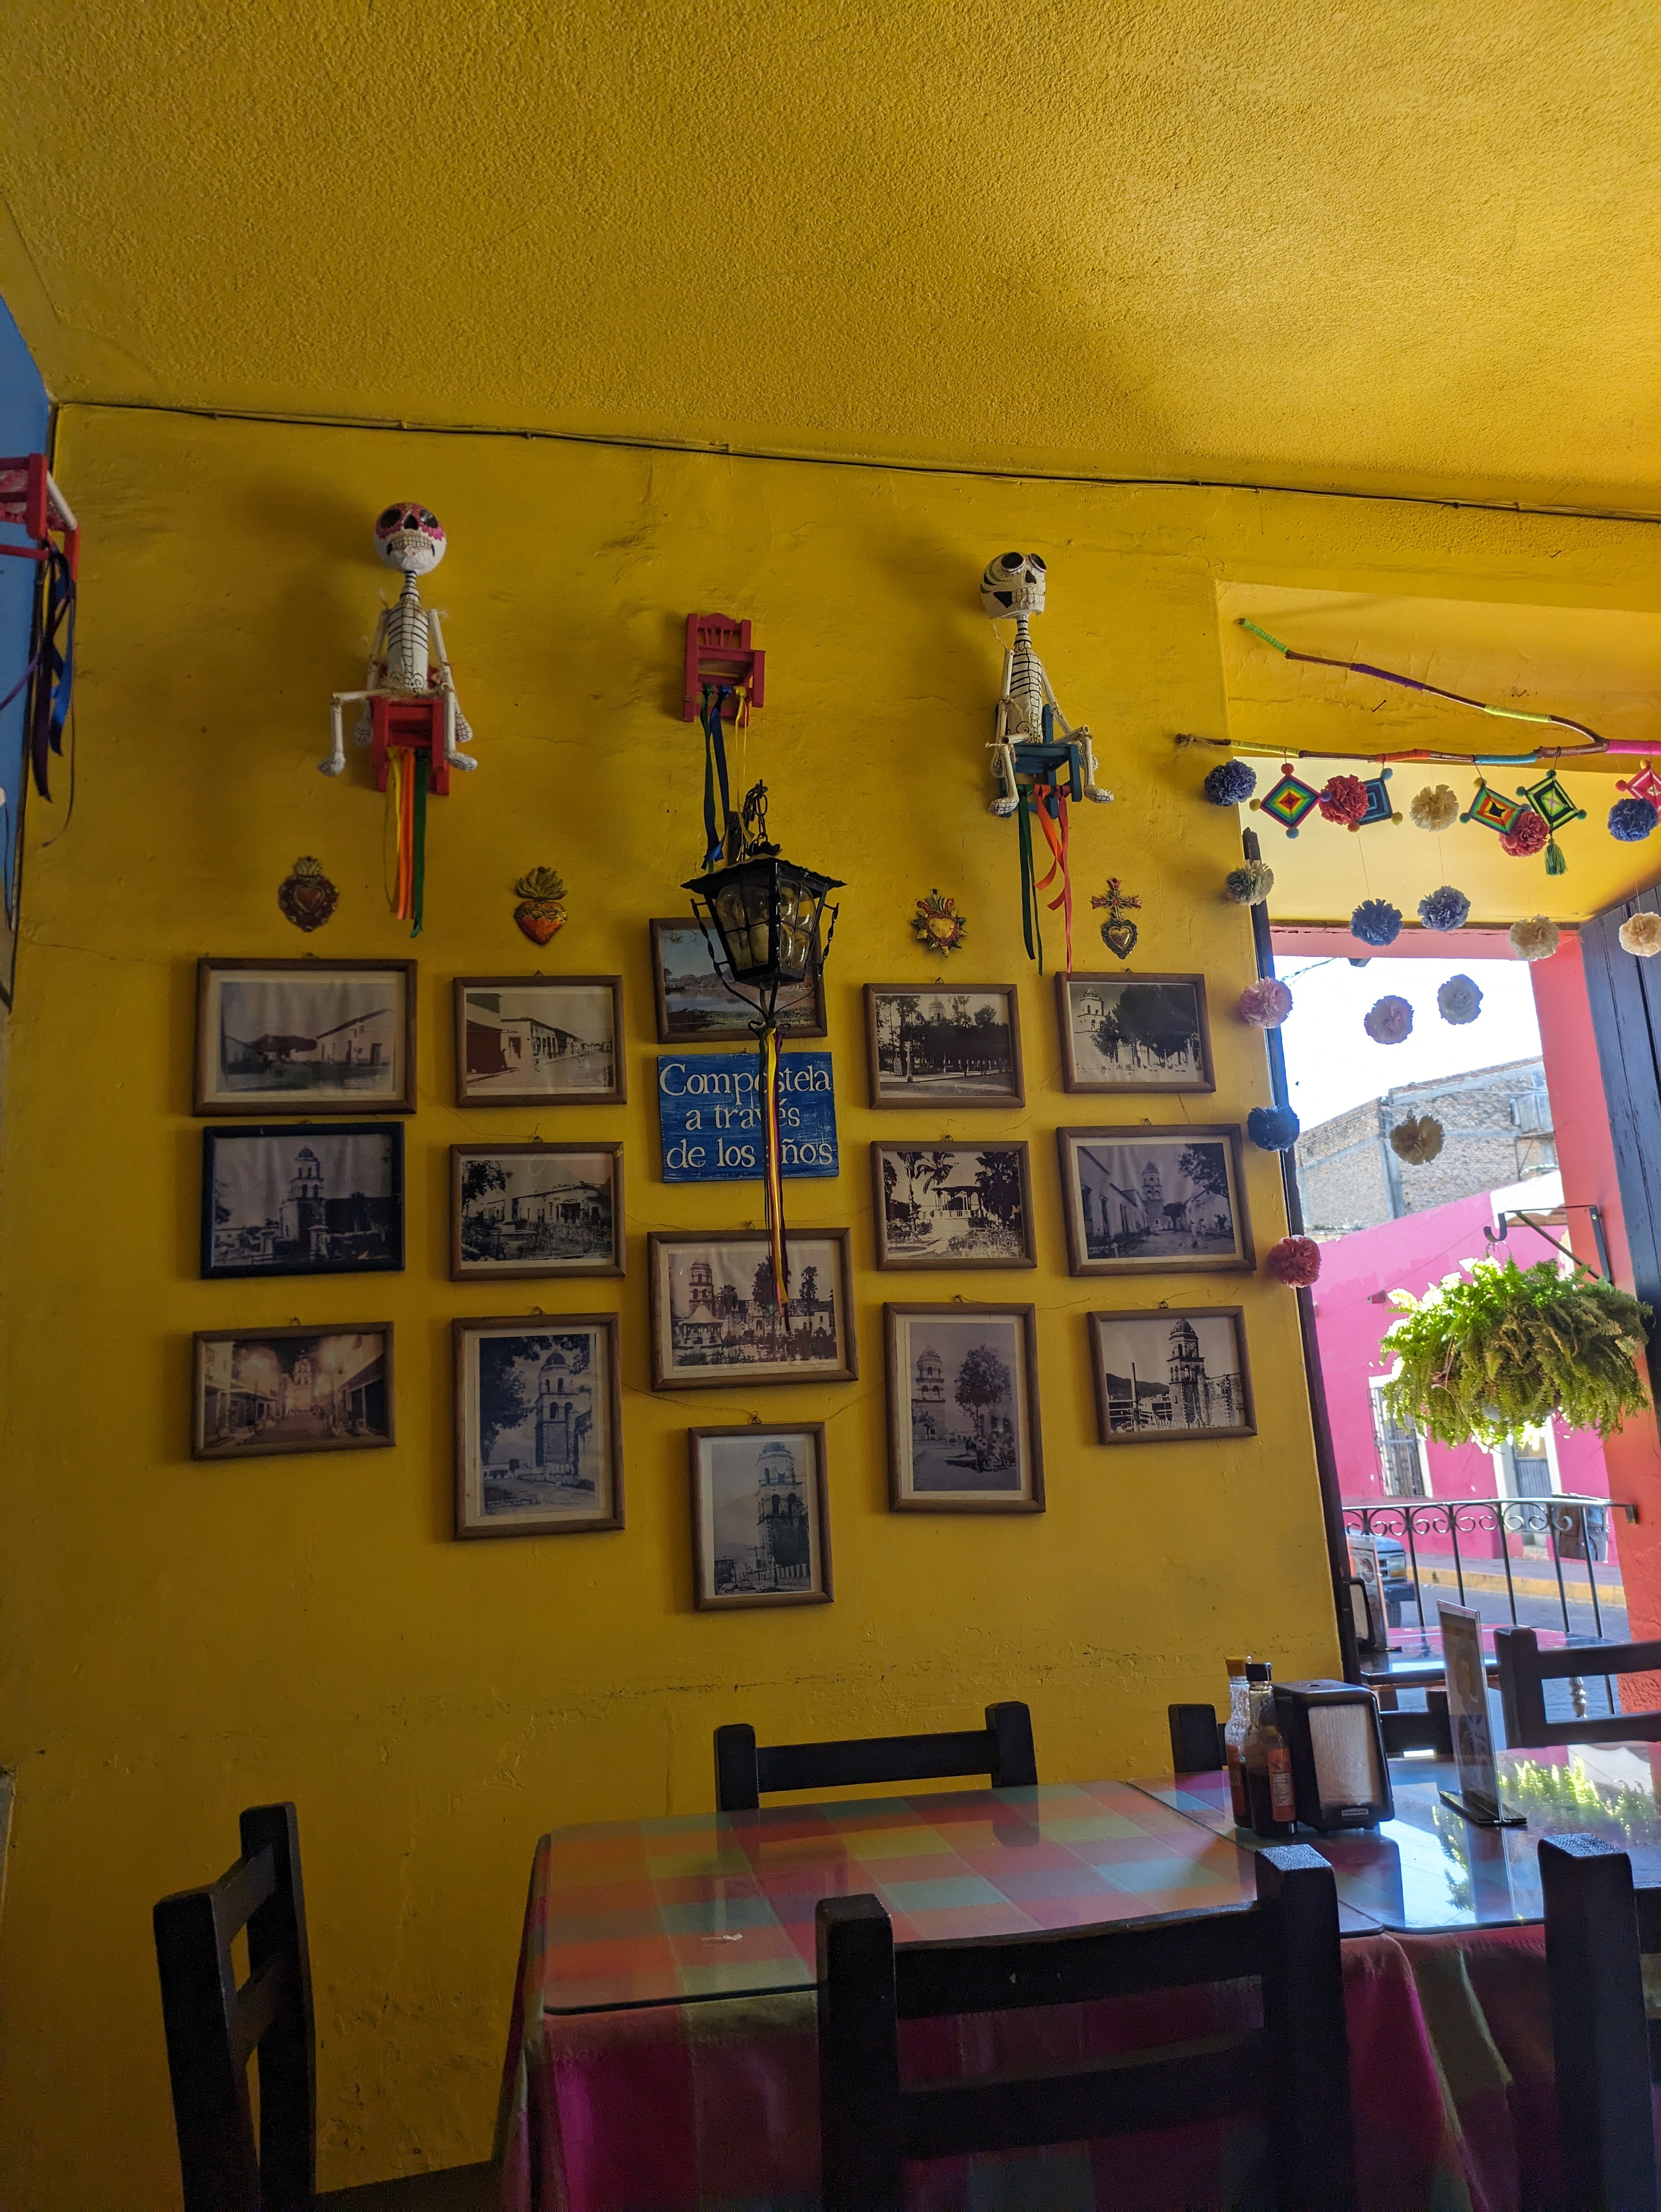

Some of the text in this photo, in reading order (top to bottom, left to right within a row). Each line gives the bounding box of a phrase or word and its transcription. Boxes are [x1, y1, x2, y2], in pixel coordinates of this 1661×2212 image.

[685, 1109, 703, 1131] a
[666, 1138, 833, 1169] de los ños
